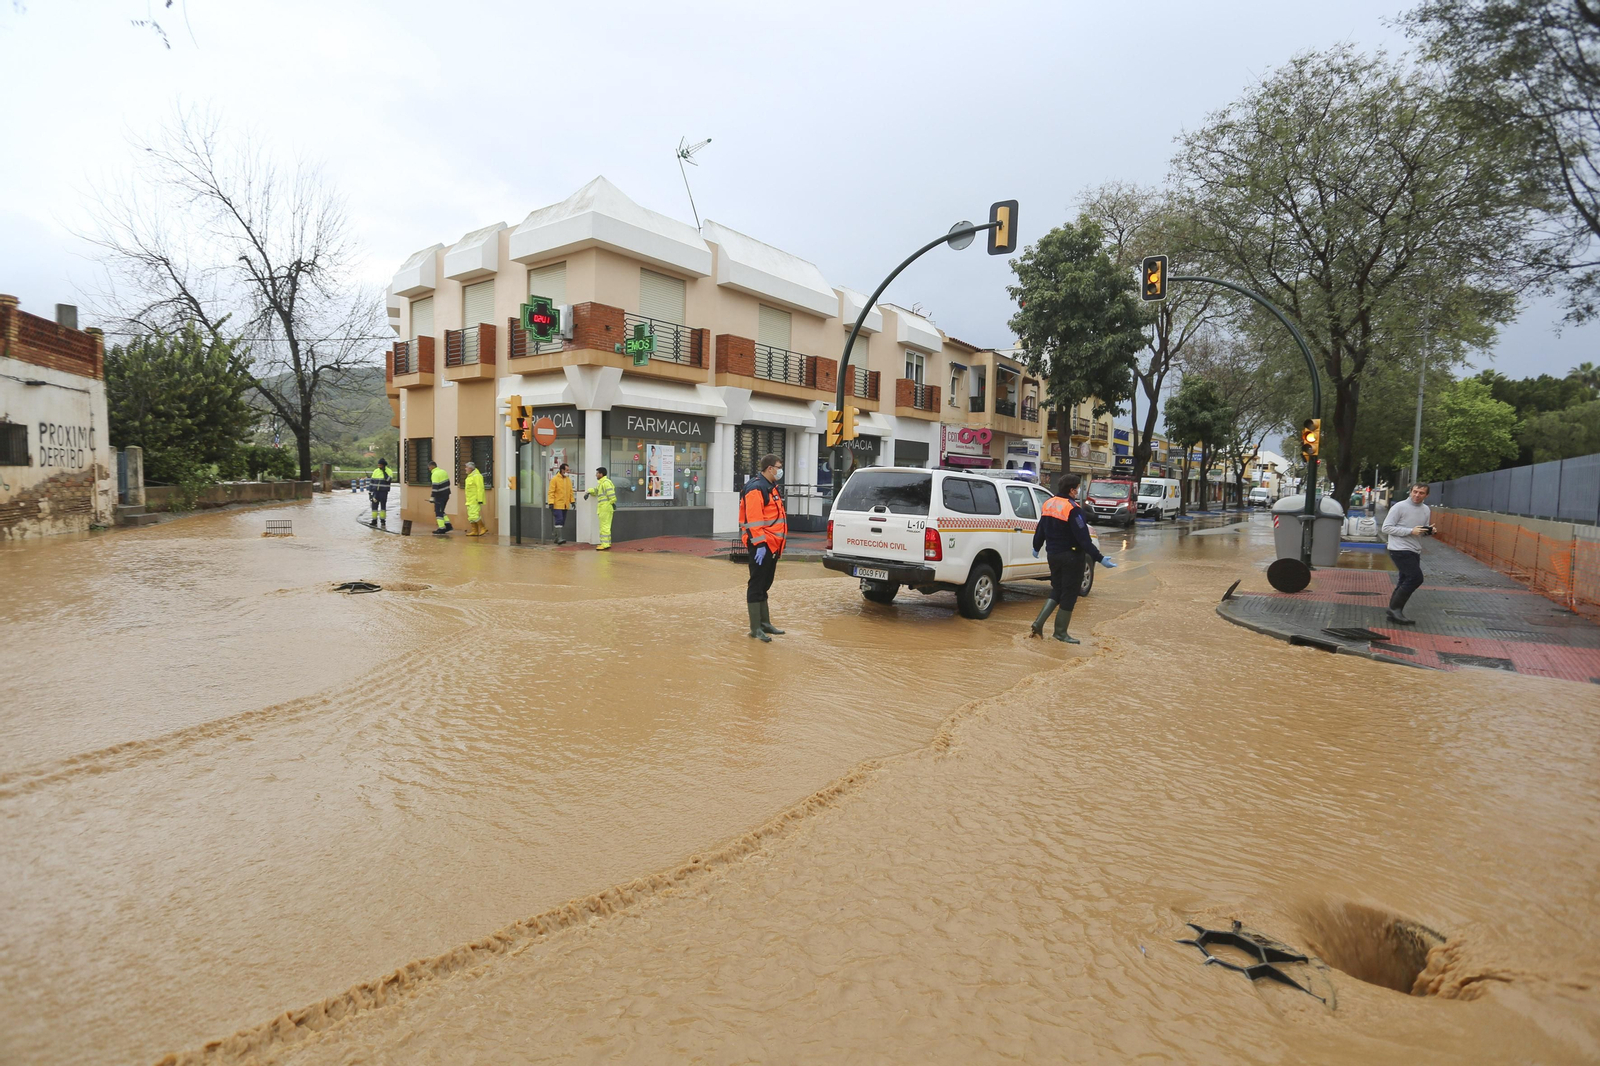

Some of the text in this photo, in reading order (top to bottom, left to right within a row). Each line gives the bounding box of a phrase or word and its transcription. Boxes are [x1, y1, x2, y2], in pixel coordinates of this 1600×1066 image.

[627, 415, 701, 436] FARMACIA
[40, 445, 84, 469] DERRIBO
[907, 520, 925, 530] L-10
[847, 538, 907, 551] PROTECCIÓN CIVIL
[858, 568, 887, 579] 0049 FVX
